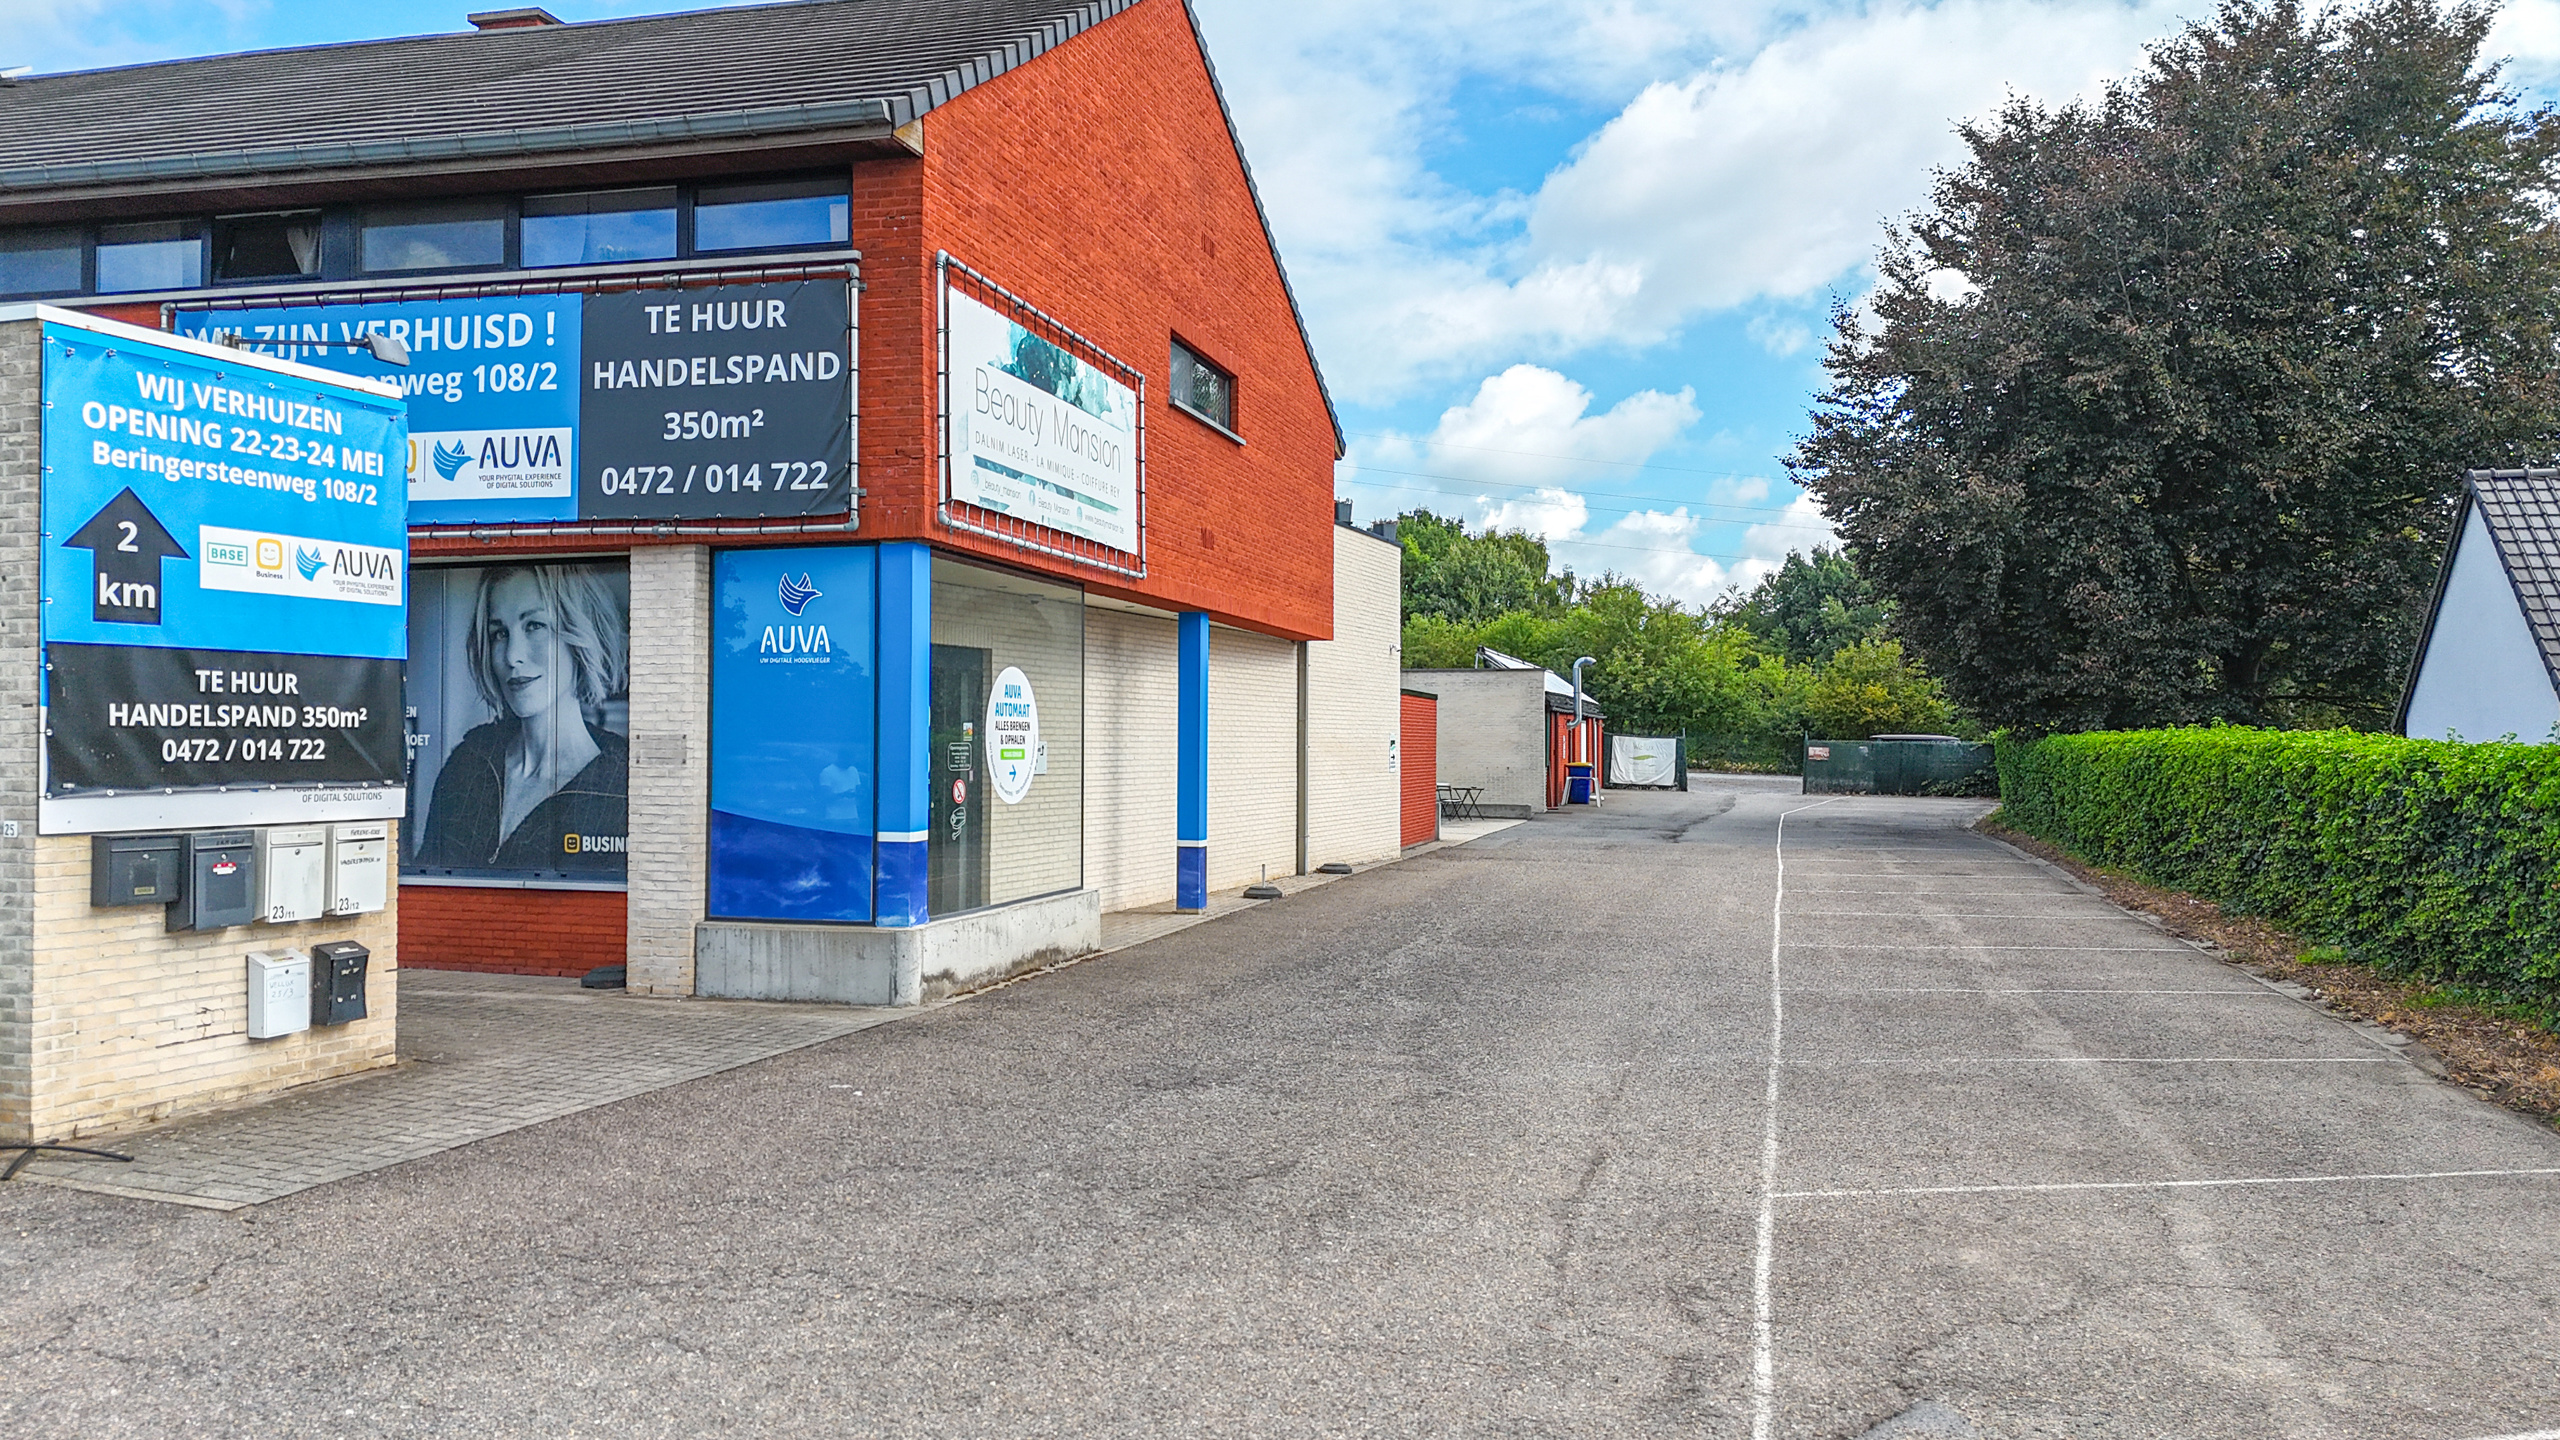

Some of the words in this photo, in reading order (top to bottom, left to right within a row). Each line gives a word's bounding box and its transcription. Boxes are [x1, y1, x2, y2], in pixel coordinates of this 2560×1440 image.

[546, 311, 555, 346] !
[644, 304, 681, 334] TE
[691, 299, 787, 332] HUUR
[472, 361, 558, 393] 108/2
[593, 351, 841, 389] HANDELSPAND
[136, 371, 185, 411] WIJ
[192, 382, 343, 436] VERHUIZEN
[663, 408, 764, 441] 350m²
[975, 367, 1044, 447] Beauty
[1054, 403, 1121, 473] Mansion
[82, 401, 222, 449] OPENING
[230, 427, 335, 468] 22-23-24
[342, 446, 384, 477] MEI
[478, 435, 562, 469] AUVA
[93, 440, 316, 502] Beringersteenweg
[321, 477, 378, 506] 108/2
[601, 465, 674, 495] 0472
[682, 464, 697, 494] /
[705, 463, 762, 493] 014
[770, 460, 829, 491] 722
[975, 430, 1005, 453] DALNIM
[1007, 443, 1029, 463] LASER
[1036, 457, 1045, 469] LA
[1047, 459, 1075, 481] MIMIQUE
[1081, 472, 1109, 495] COIFFURE
[1110, 484, 1120, 498] REY
[519, 480, 553, 488] SOLUTIONS
[1038, 497, 1053, 511] Beauty
[117, 521, 139, 552] 2
[211, 547, 244, 562] BASE
[333, 549, 395, 580] AUVA
[256, 570, 283, 580] Business
[99, 573, 156, 608] km
[760, 625, 831, 654] AUVA
[195, 670, 224, 693] TE
[231, 671, 299, 694] HUUR
[1004, 684, 1022, 699] AUVA
[109, 703, 296, 728] HANDELSPAND
[302, 706, 368, 729] 350m²
[995, 702, 1030, 718] AUTOMAAT
[995, 720, 1009, 731] ALLES
[1009, 721, 1030, 731] BRENGEN
[162, 739, 220, 762] 0472
[225, 739, 237, 761] /
[242, 739, 283, 761] 014
[288, 738, 326, 760] 722
[1005, 734, 1026, 745] OPHALEN
[302, 794, 312, 803] OF
[314, 793, 342, 803] DIGITAL
[344, 791, 383, 801] SOLUTIONS
[5, 823, 15, 836] 25
[582, 835, 629, 853] BUSIN
[272, 905, 295, 920] 23/11
[338, 897, 360, 912] 23/12
